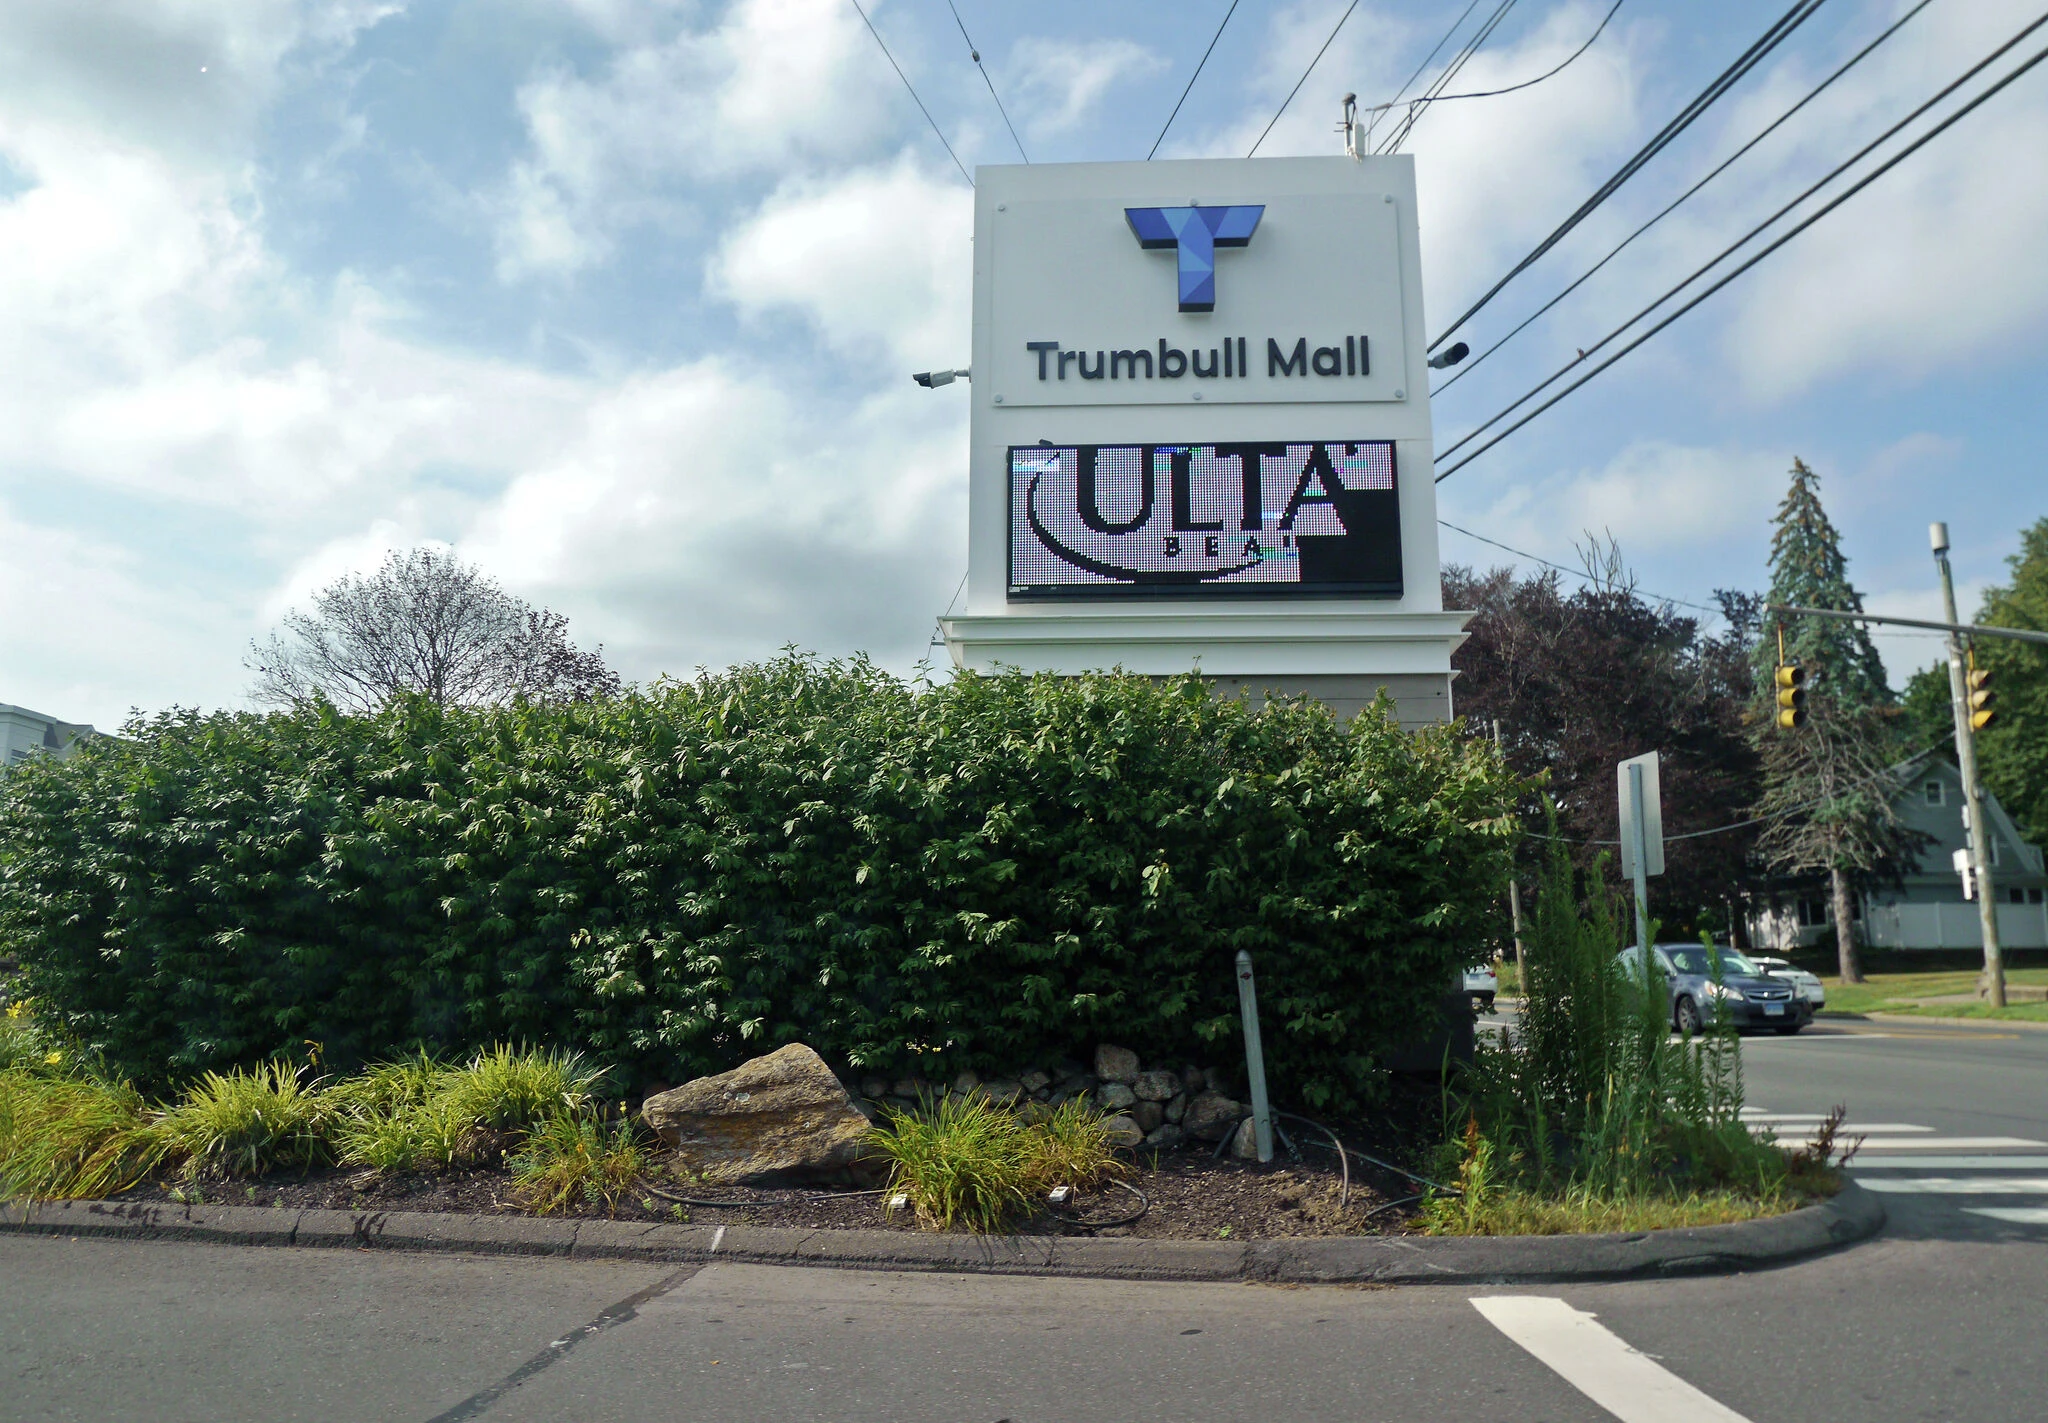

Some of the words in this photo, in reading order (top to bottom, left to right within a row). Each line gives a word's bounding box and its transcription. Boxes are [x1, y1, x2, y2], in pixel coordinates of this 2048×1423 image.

[1027, 337, 1246, 380] Trumbull
[1268, 335, 1370, 377] Mall
[1076, 443, 1347, 535] ULTA
